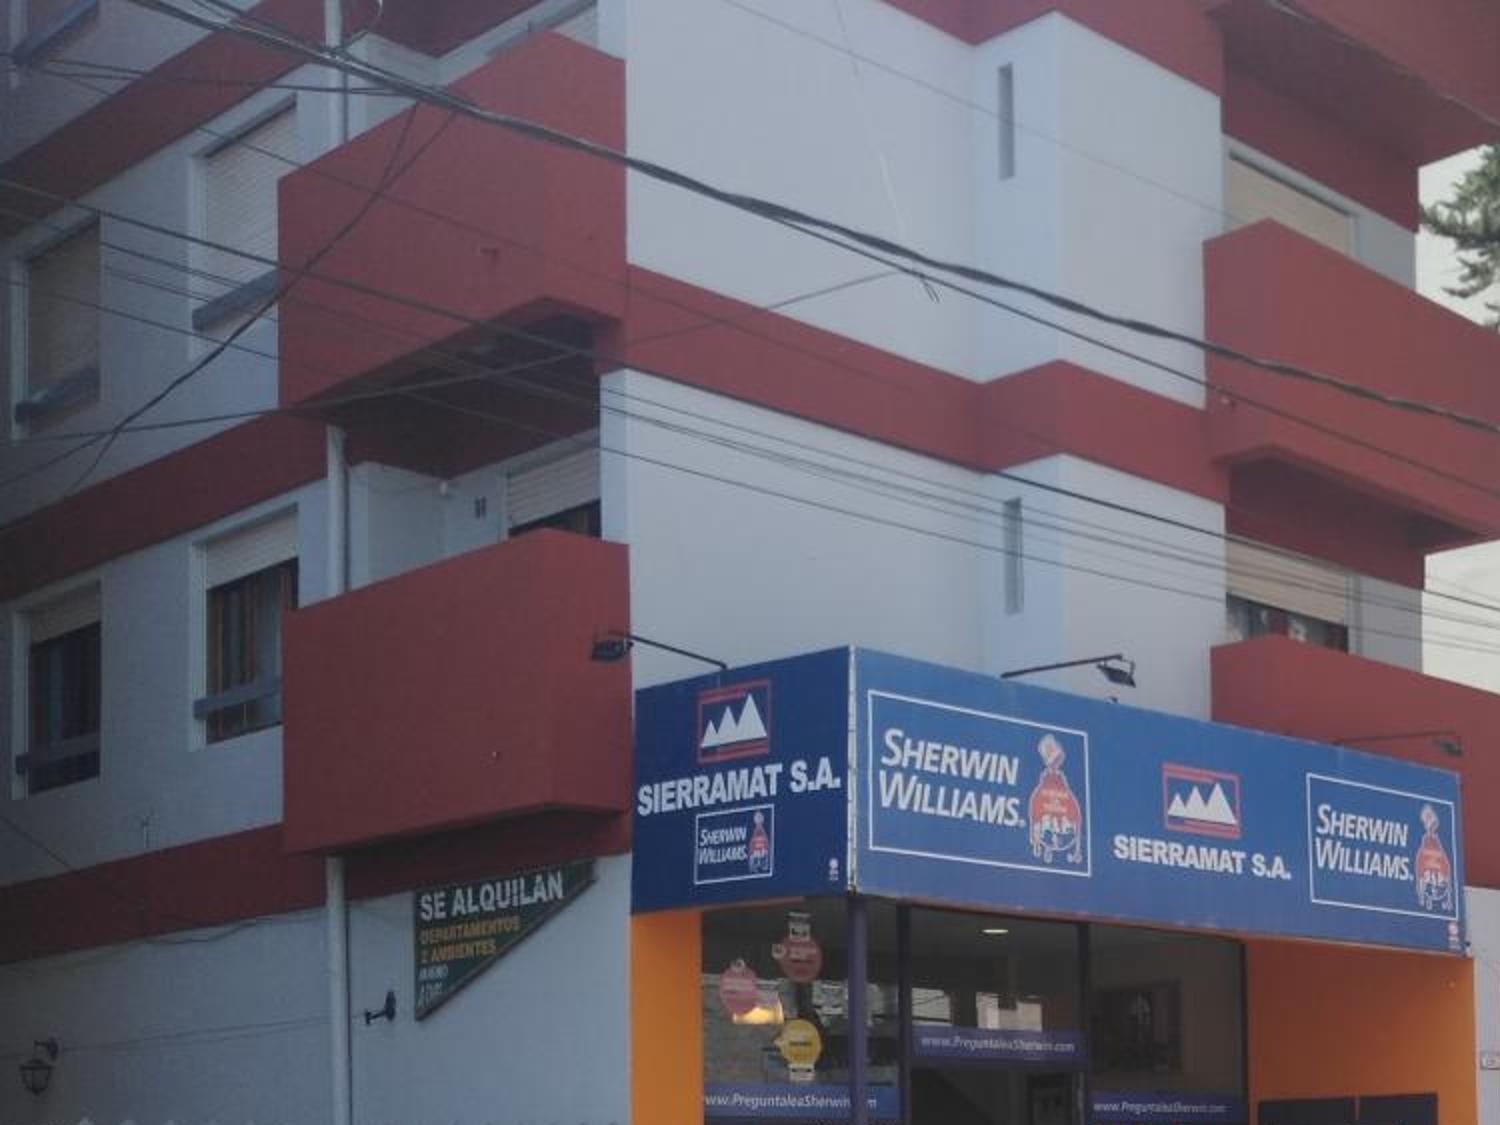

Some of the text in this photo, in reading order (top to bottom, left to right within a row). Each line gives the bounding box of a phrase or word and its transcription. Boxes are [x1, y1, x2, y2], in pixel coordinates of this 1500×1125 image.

[880, 727, 1019, 786] SHERWIN
[637, 756, 841, 817] SIERRAMAT S.A.
[699, 825, 748, 847] SHERWIN
[1315, 803, 1409, 848] SHERWIN
[1112, 834, 1292, 881] SIERRAMAT S.A.
[420, 870, 564, 921] SE ALQUILAN
